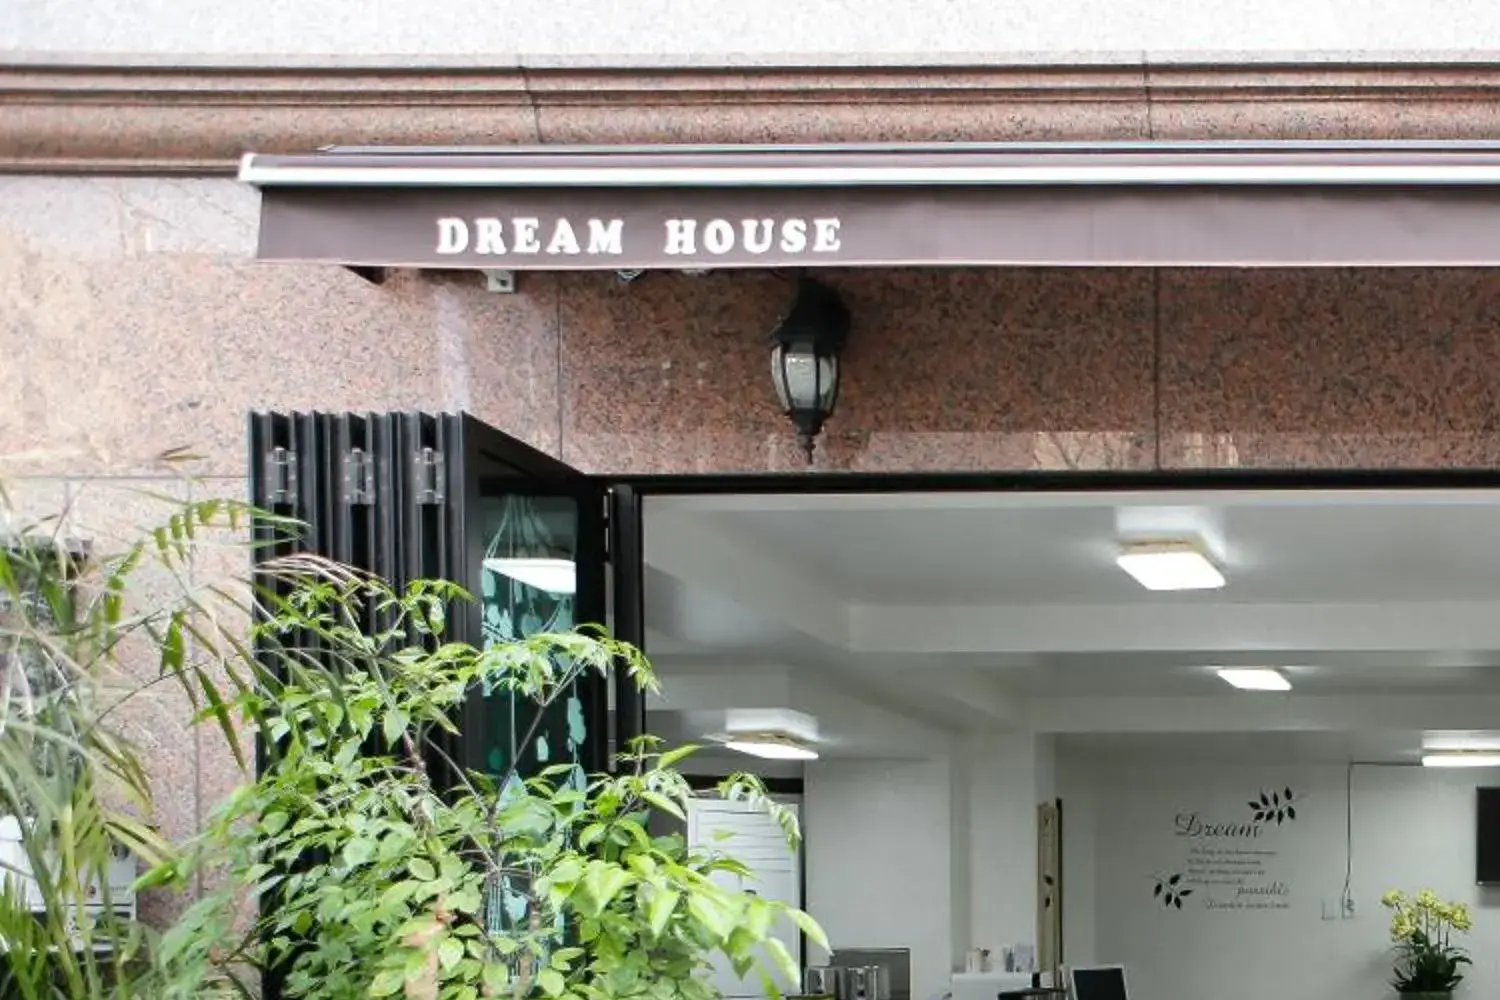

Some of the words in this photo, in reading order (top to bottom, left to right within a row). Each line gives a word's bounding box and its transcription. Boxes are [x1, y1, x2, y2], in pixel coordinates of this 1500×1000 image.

[436, 217, 625, 255] DREAM
[664, 217, 841, 254] HOUSE
[1175, 813, 1262, 837] Dream
